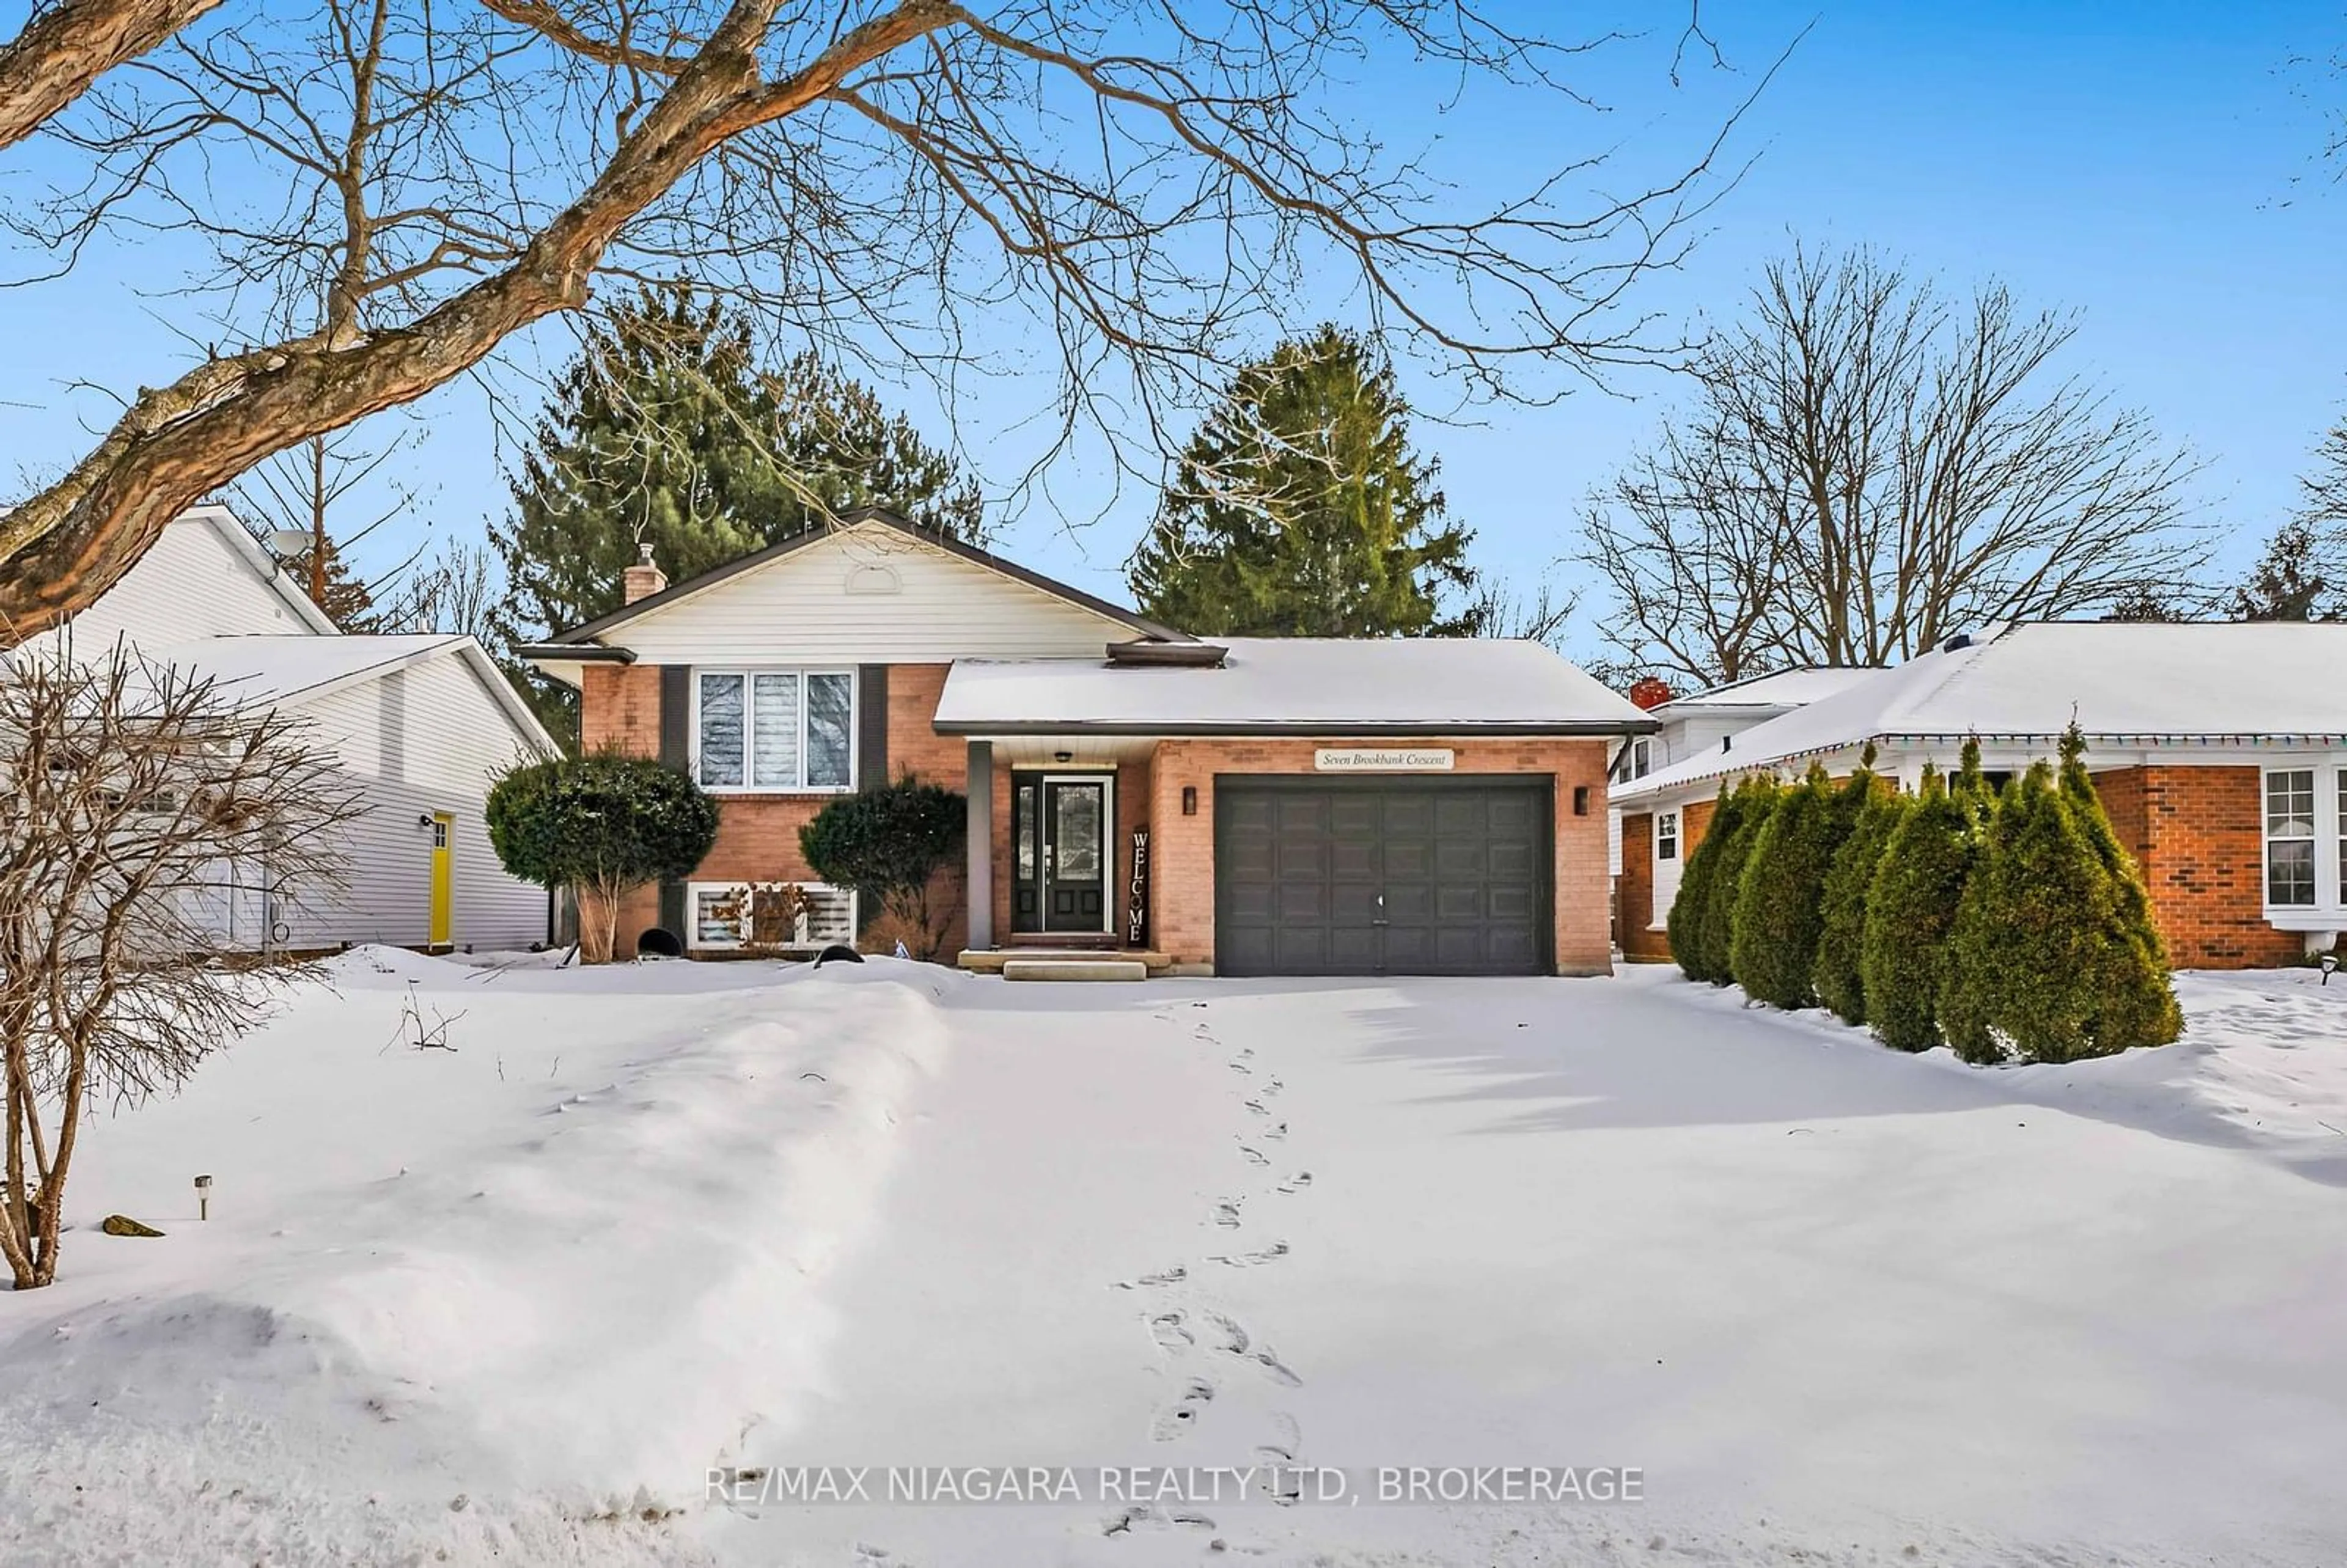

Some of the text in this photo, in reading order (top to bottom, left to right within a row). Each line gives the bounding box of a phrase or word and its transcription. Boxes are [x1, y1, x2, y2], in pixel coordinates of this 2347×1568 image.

[1323, 753, 1446, 765] Seven Brookbank Crescent
[1129, 833, 1148, 942] WELCOME
